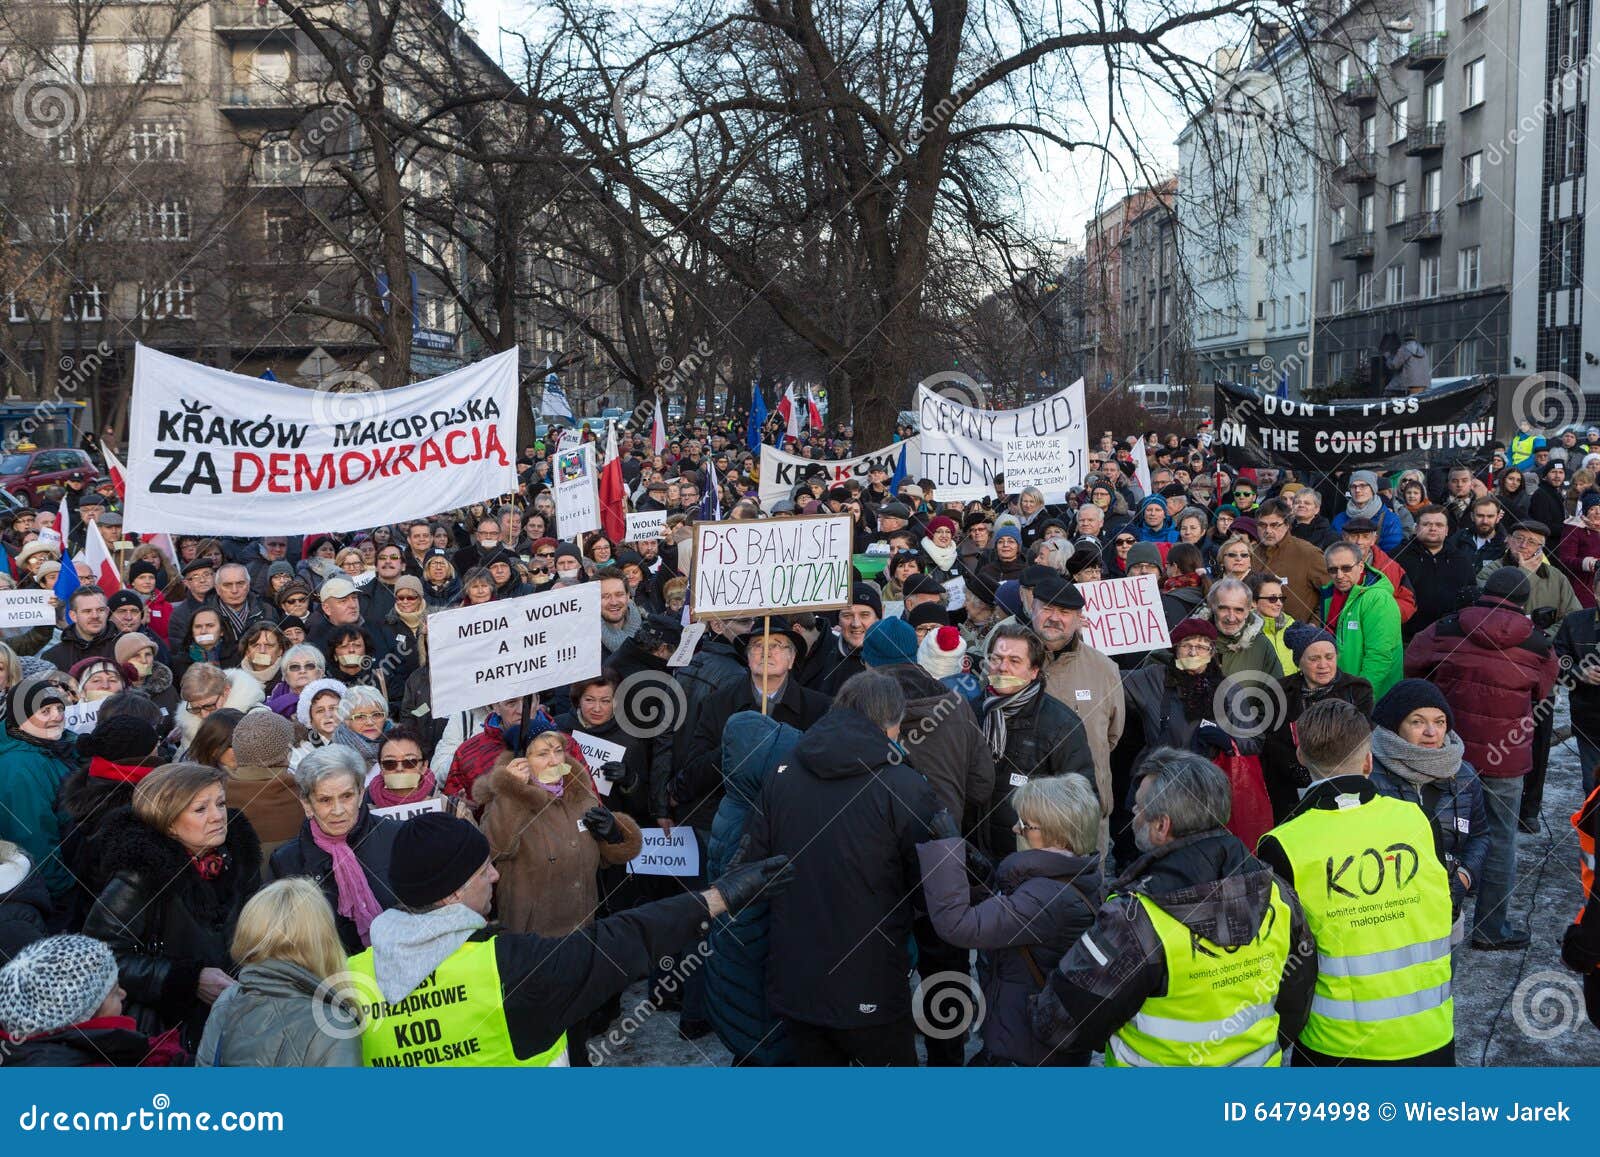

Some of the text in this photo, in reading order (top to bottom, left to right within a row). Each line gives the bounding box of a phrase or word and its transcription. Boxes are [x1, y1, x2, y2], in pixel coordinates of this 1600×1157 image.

[333, 397, 500, 447] MAŁOPOLSKA
[1220, 416, 1495, 453] ON THE CONSTITUTION!
[149, 424, 509, 494] ZA DEMOKRACJĄ
[921, 452, 972, 486] TEGO
[632, 519, 662, 529] WOLNE
[633, 532, 660, 540] MEDIA
[702, 527, 738, 565] PiS
[6, 596, 44, 605] WOLNE
[700, 569, 764, 607] NASZĄ
[1081, 577, 1153, 612] WOLNE
[8, 611, 43, 620] MEDIA
[458, 599, 582, 639] MEDIA WOLNE,
[1087, 608, 1165, 649] MEDIA
[498, 631, 547, 654] A NIE
[475, 646, 577, 684] PARTYJNE !!!!
[644, 836, 684, 847] MEDIA
[641, 855, 686, 866] WOLNE
[1326, 843, 1419, 900] KOD
[1326, 907, 1356, 918] komitet
[1358, 902, 1383, 914] obrony
[1189, 967, 1219, 980] komitet
[394, 1018, 442, 1048] KOD
[371, 1037, 481, 1067] MAŁOPOLSKIE
